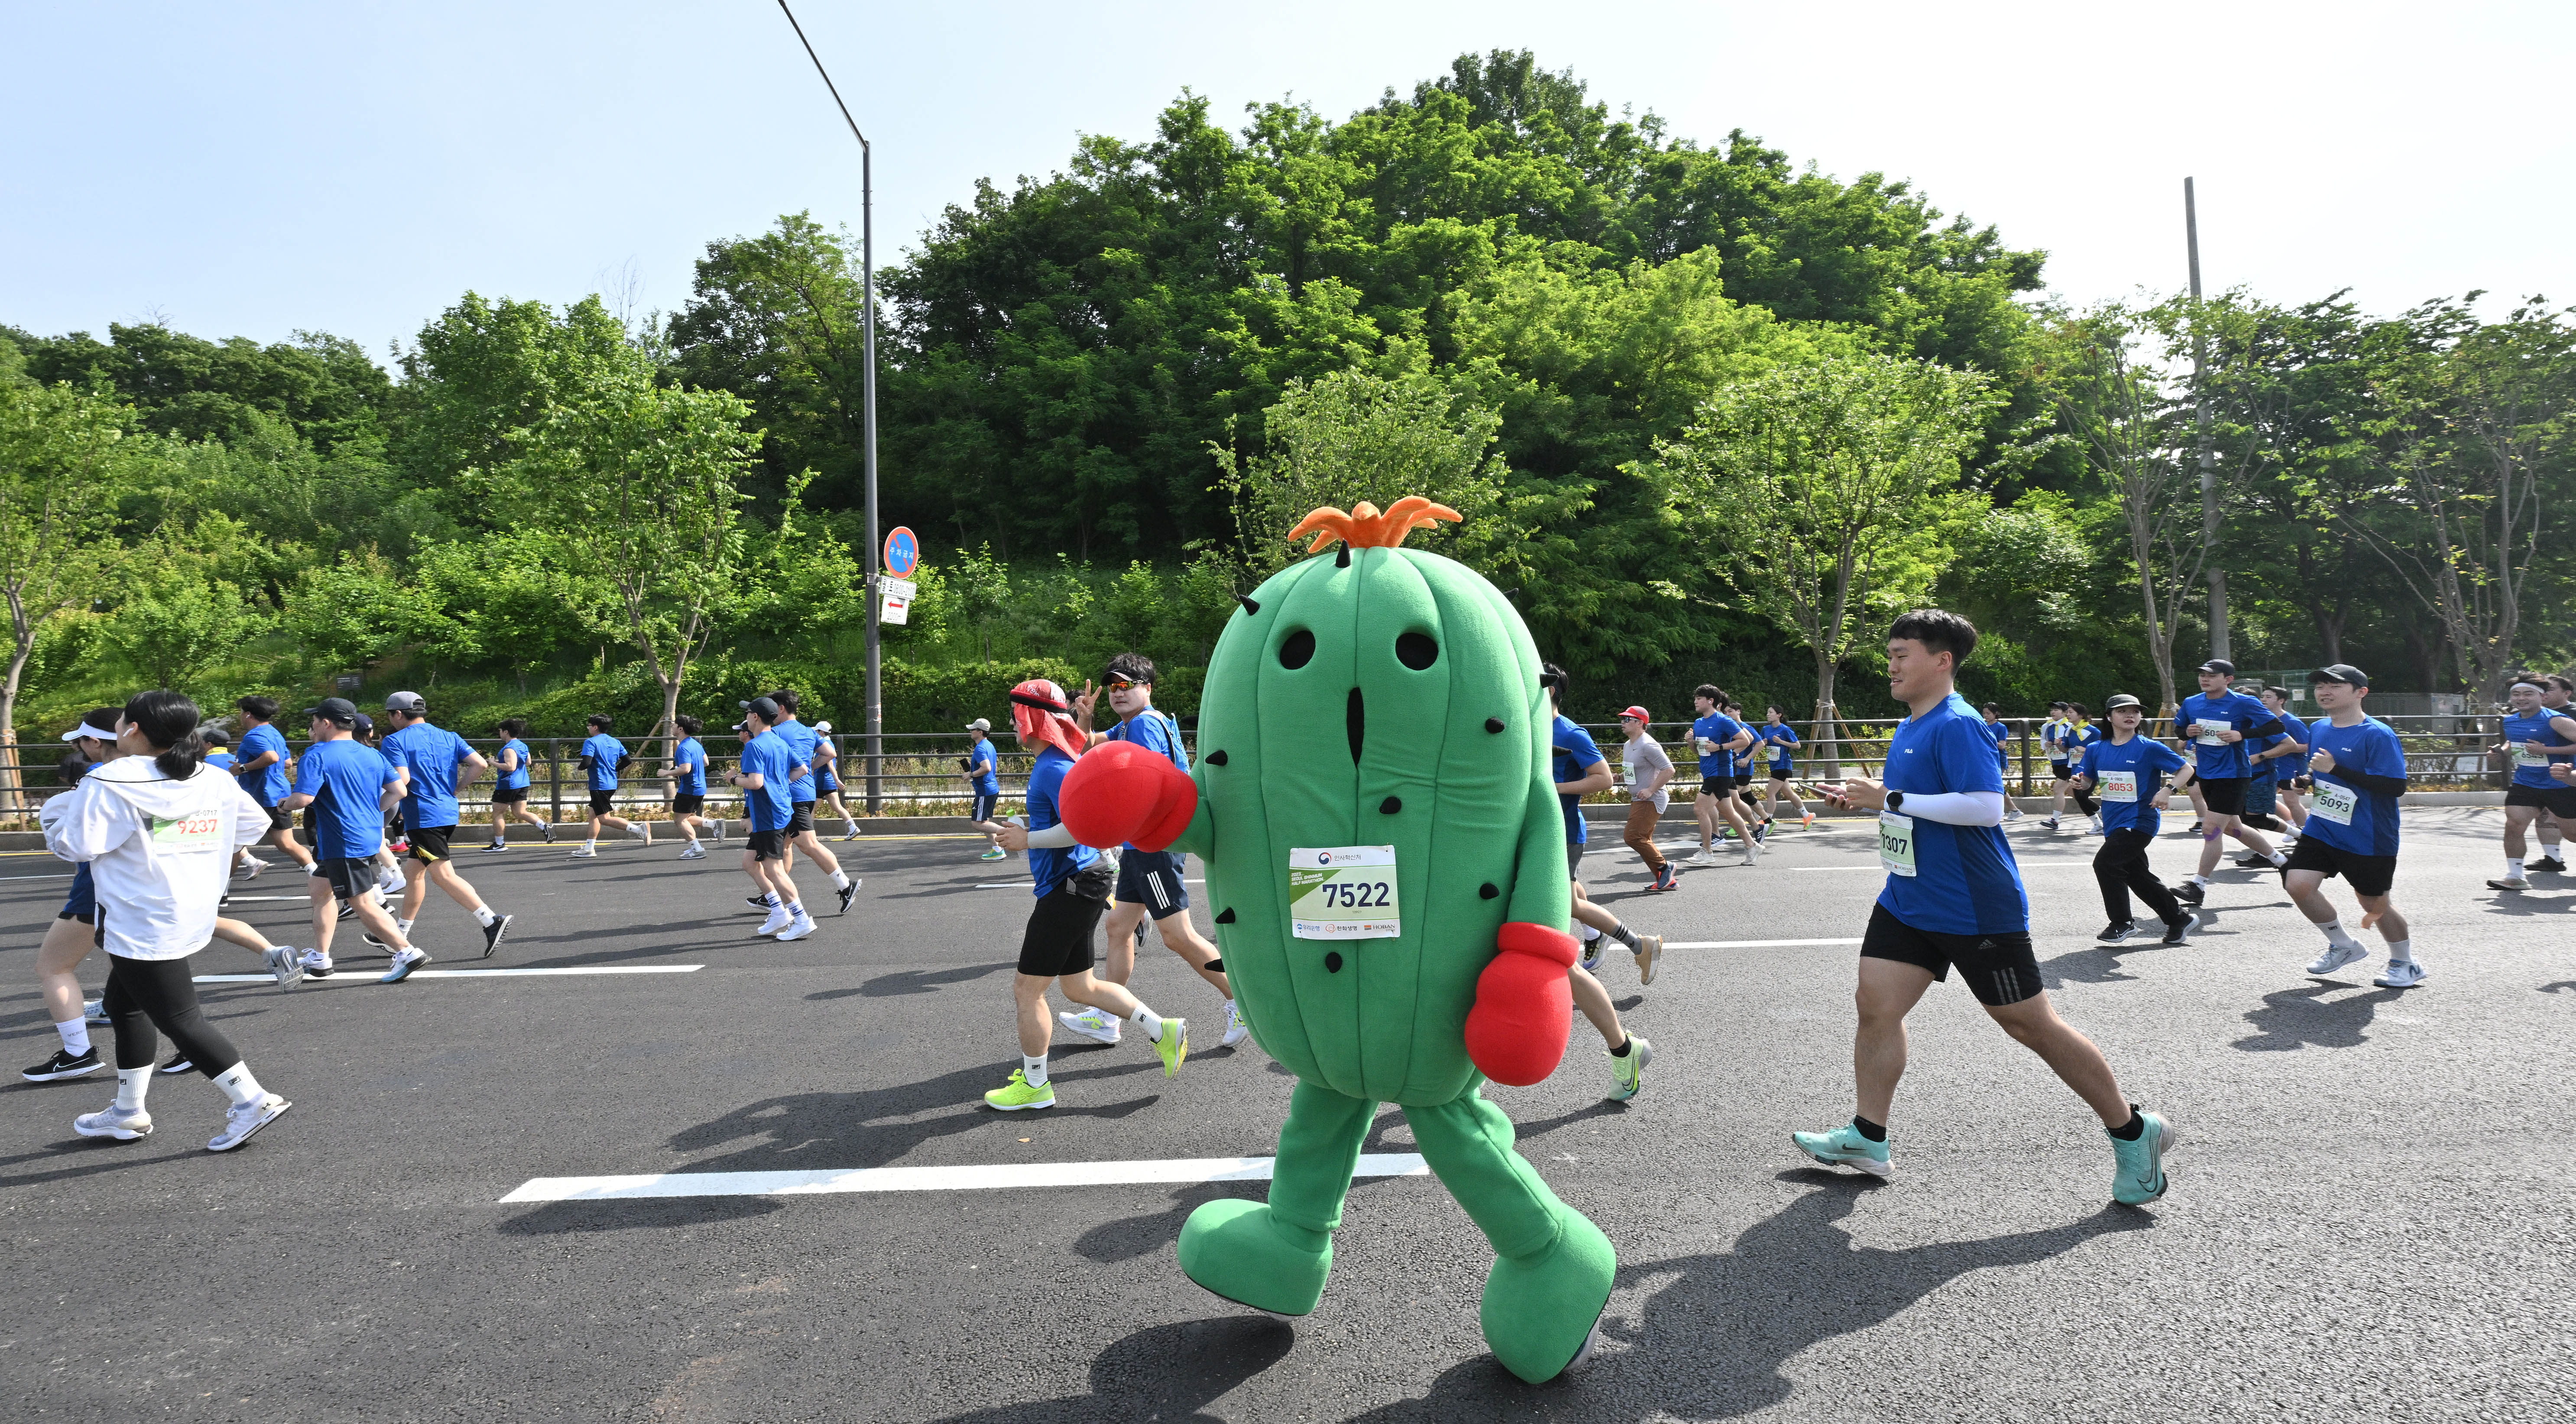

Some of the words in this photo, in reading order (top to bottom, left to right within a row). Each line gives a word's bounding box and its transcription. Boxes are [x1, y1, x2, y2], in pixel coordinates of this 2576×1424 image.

[889, 547, 914, 559] 주차금지
[2109, 783, 2133, 792] 8053
[2320, 796, 2350, 812] 5093
[178, 819, 217, 834] 9237
[1882, 832, 1908, 855] 7307
[1322, 882, 1390, 908] 7522
